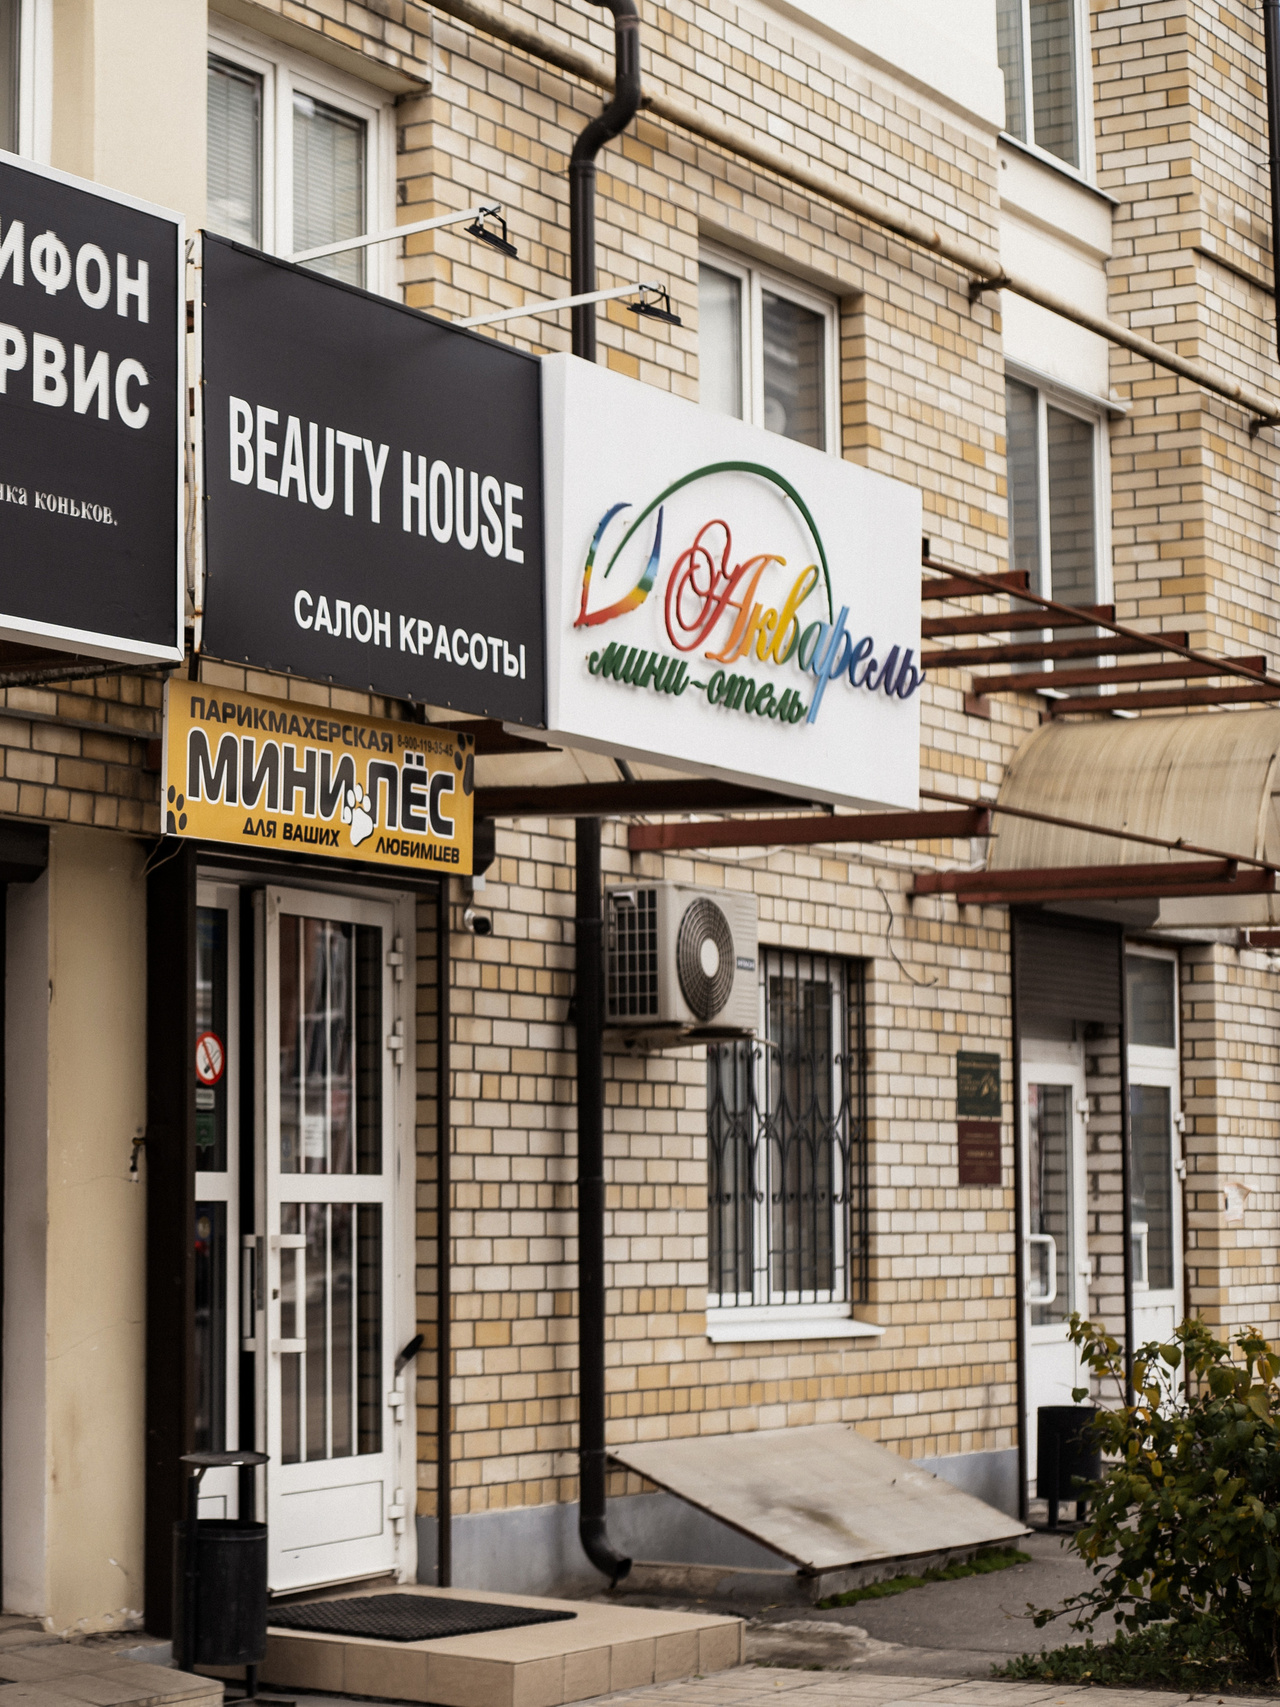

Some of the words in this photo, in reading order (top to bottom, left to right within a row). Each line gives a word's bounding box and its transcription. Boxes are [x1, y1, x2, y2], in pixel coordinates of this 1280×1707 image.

[35, 490, 118, 526] коньков.
[229, 395, 390, 524] BEAUTY
[402, 450, 524, 564] HOUSE
[294, 589, 392, 649] САЛОН
[399, 614, 526, 680] КРАСОТЫ
[665, 519, 926, 724] Акварель
[190, 696, 394, 754] ПАРИКМАХЕРСКАЯ
[397, 734, 454, 758] 8-900-119-35-45
[186, 726, 357, 822] МИНИ
[368, 750, 456, 840] ПЁС
[242, 816, 276, 839] ДЛЯ
[282, 822, 341, 848] ВАШИХ
[376, 836, 460, 865] ЛЮБИМЦЕВ
